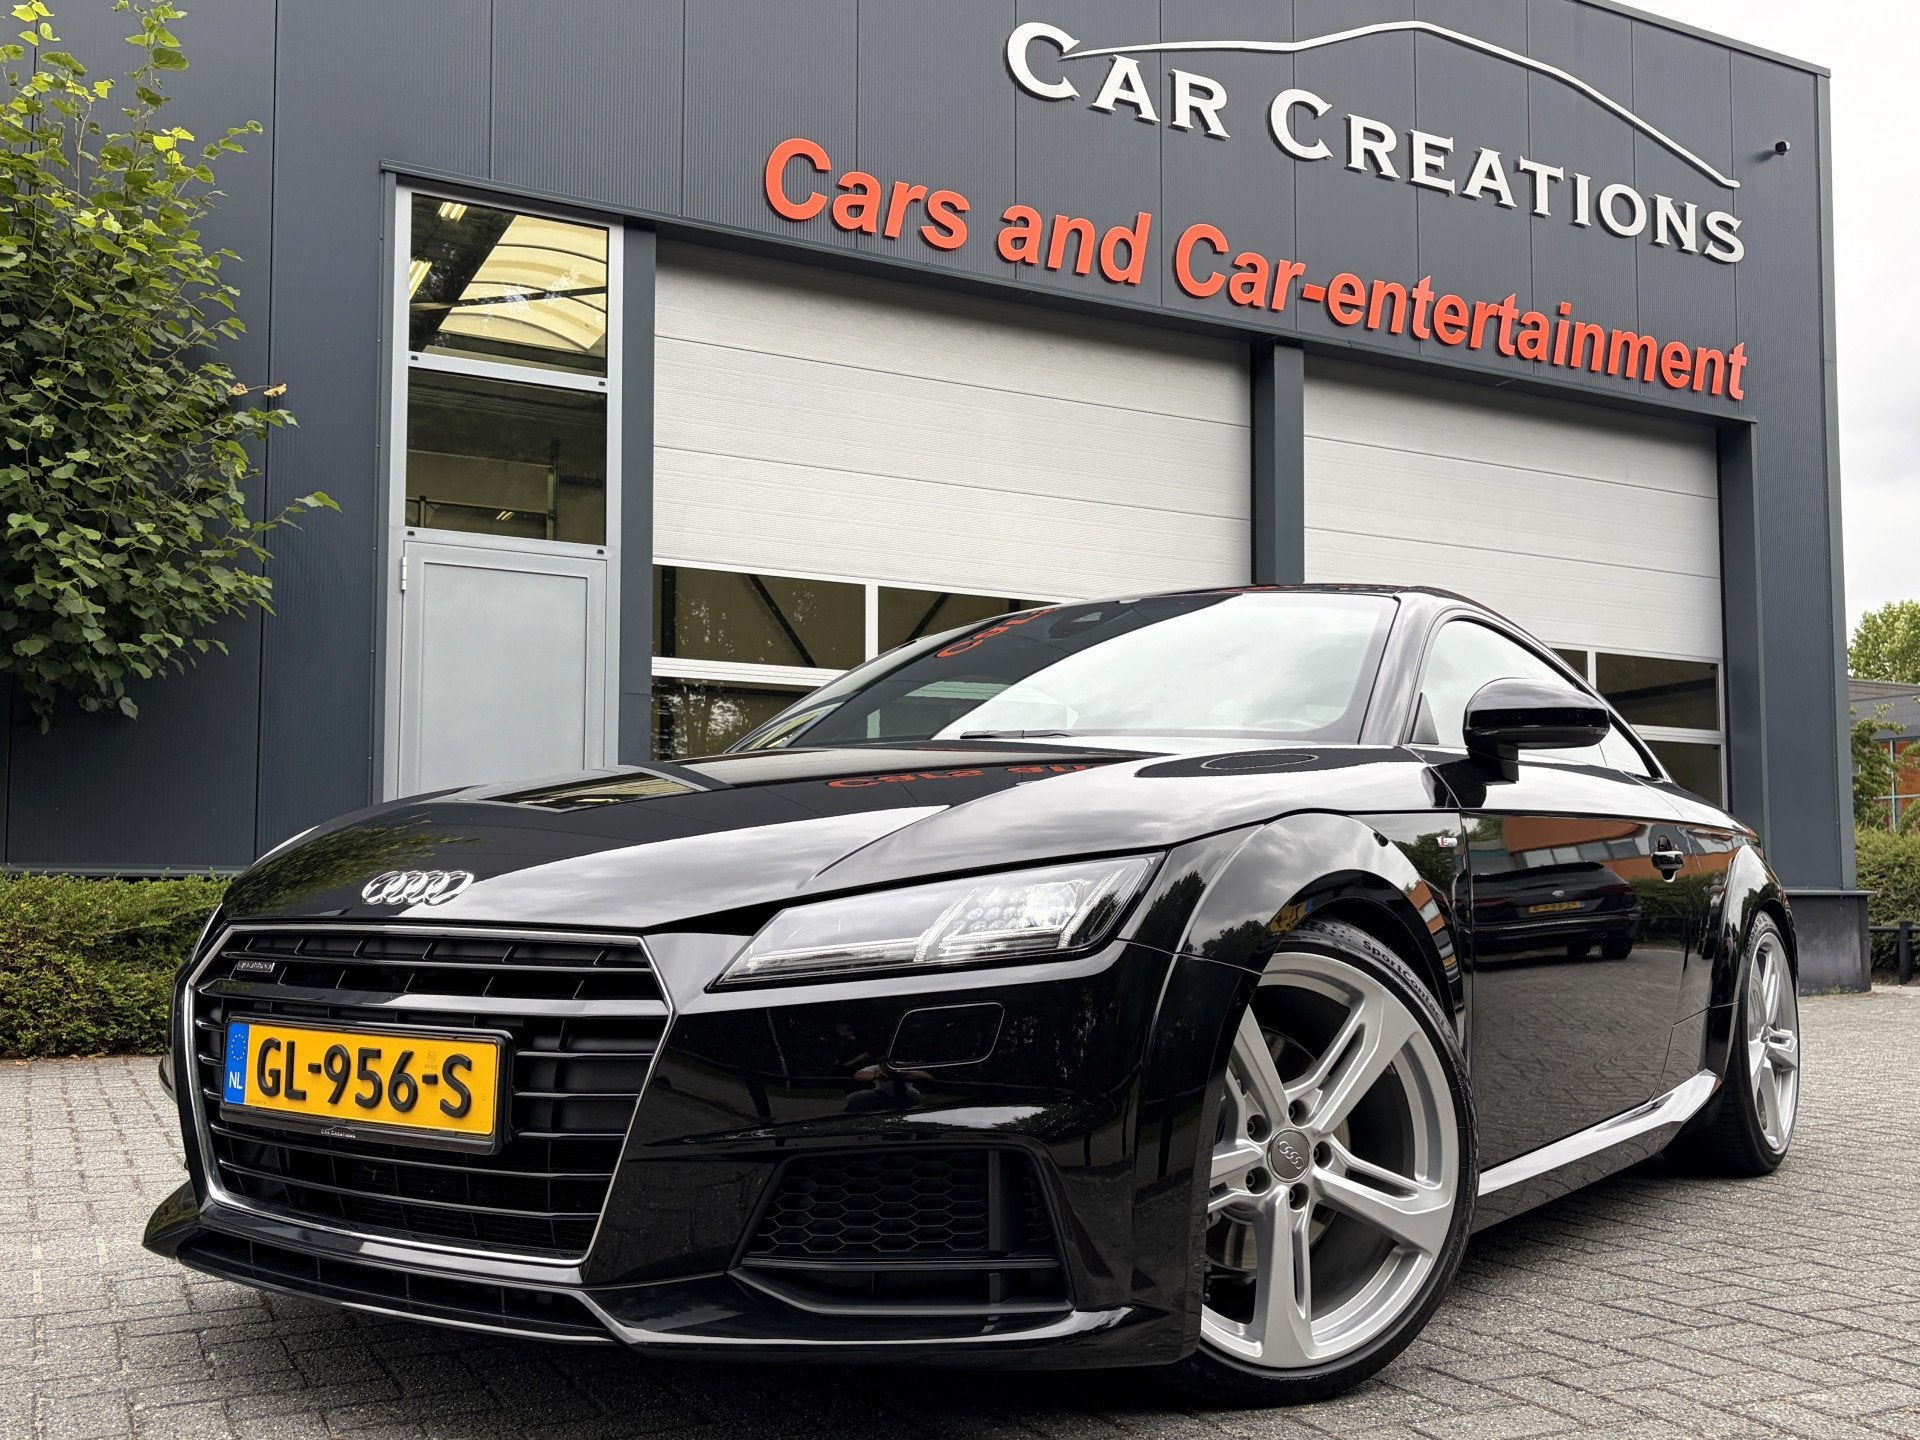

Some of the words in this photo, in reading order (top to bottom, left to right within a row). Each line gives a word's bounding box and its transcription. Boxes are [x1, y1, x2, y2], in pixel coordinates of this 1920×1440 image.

[1006, 21, 1231, 139] CAR
[1270, 88, 1745, 264] CREATIONS
[764, 137, 970, 249] Cars
[997, 204, 1152, 285] and
[1175, 223, 1748, 400] Car-entertainment
[228, 1070, 243, 1090] NL
[256, 1037, 472, 1119] GL-956-S
